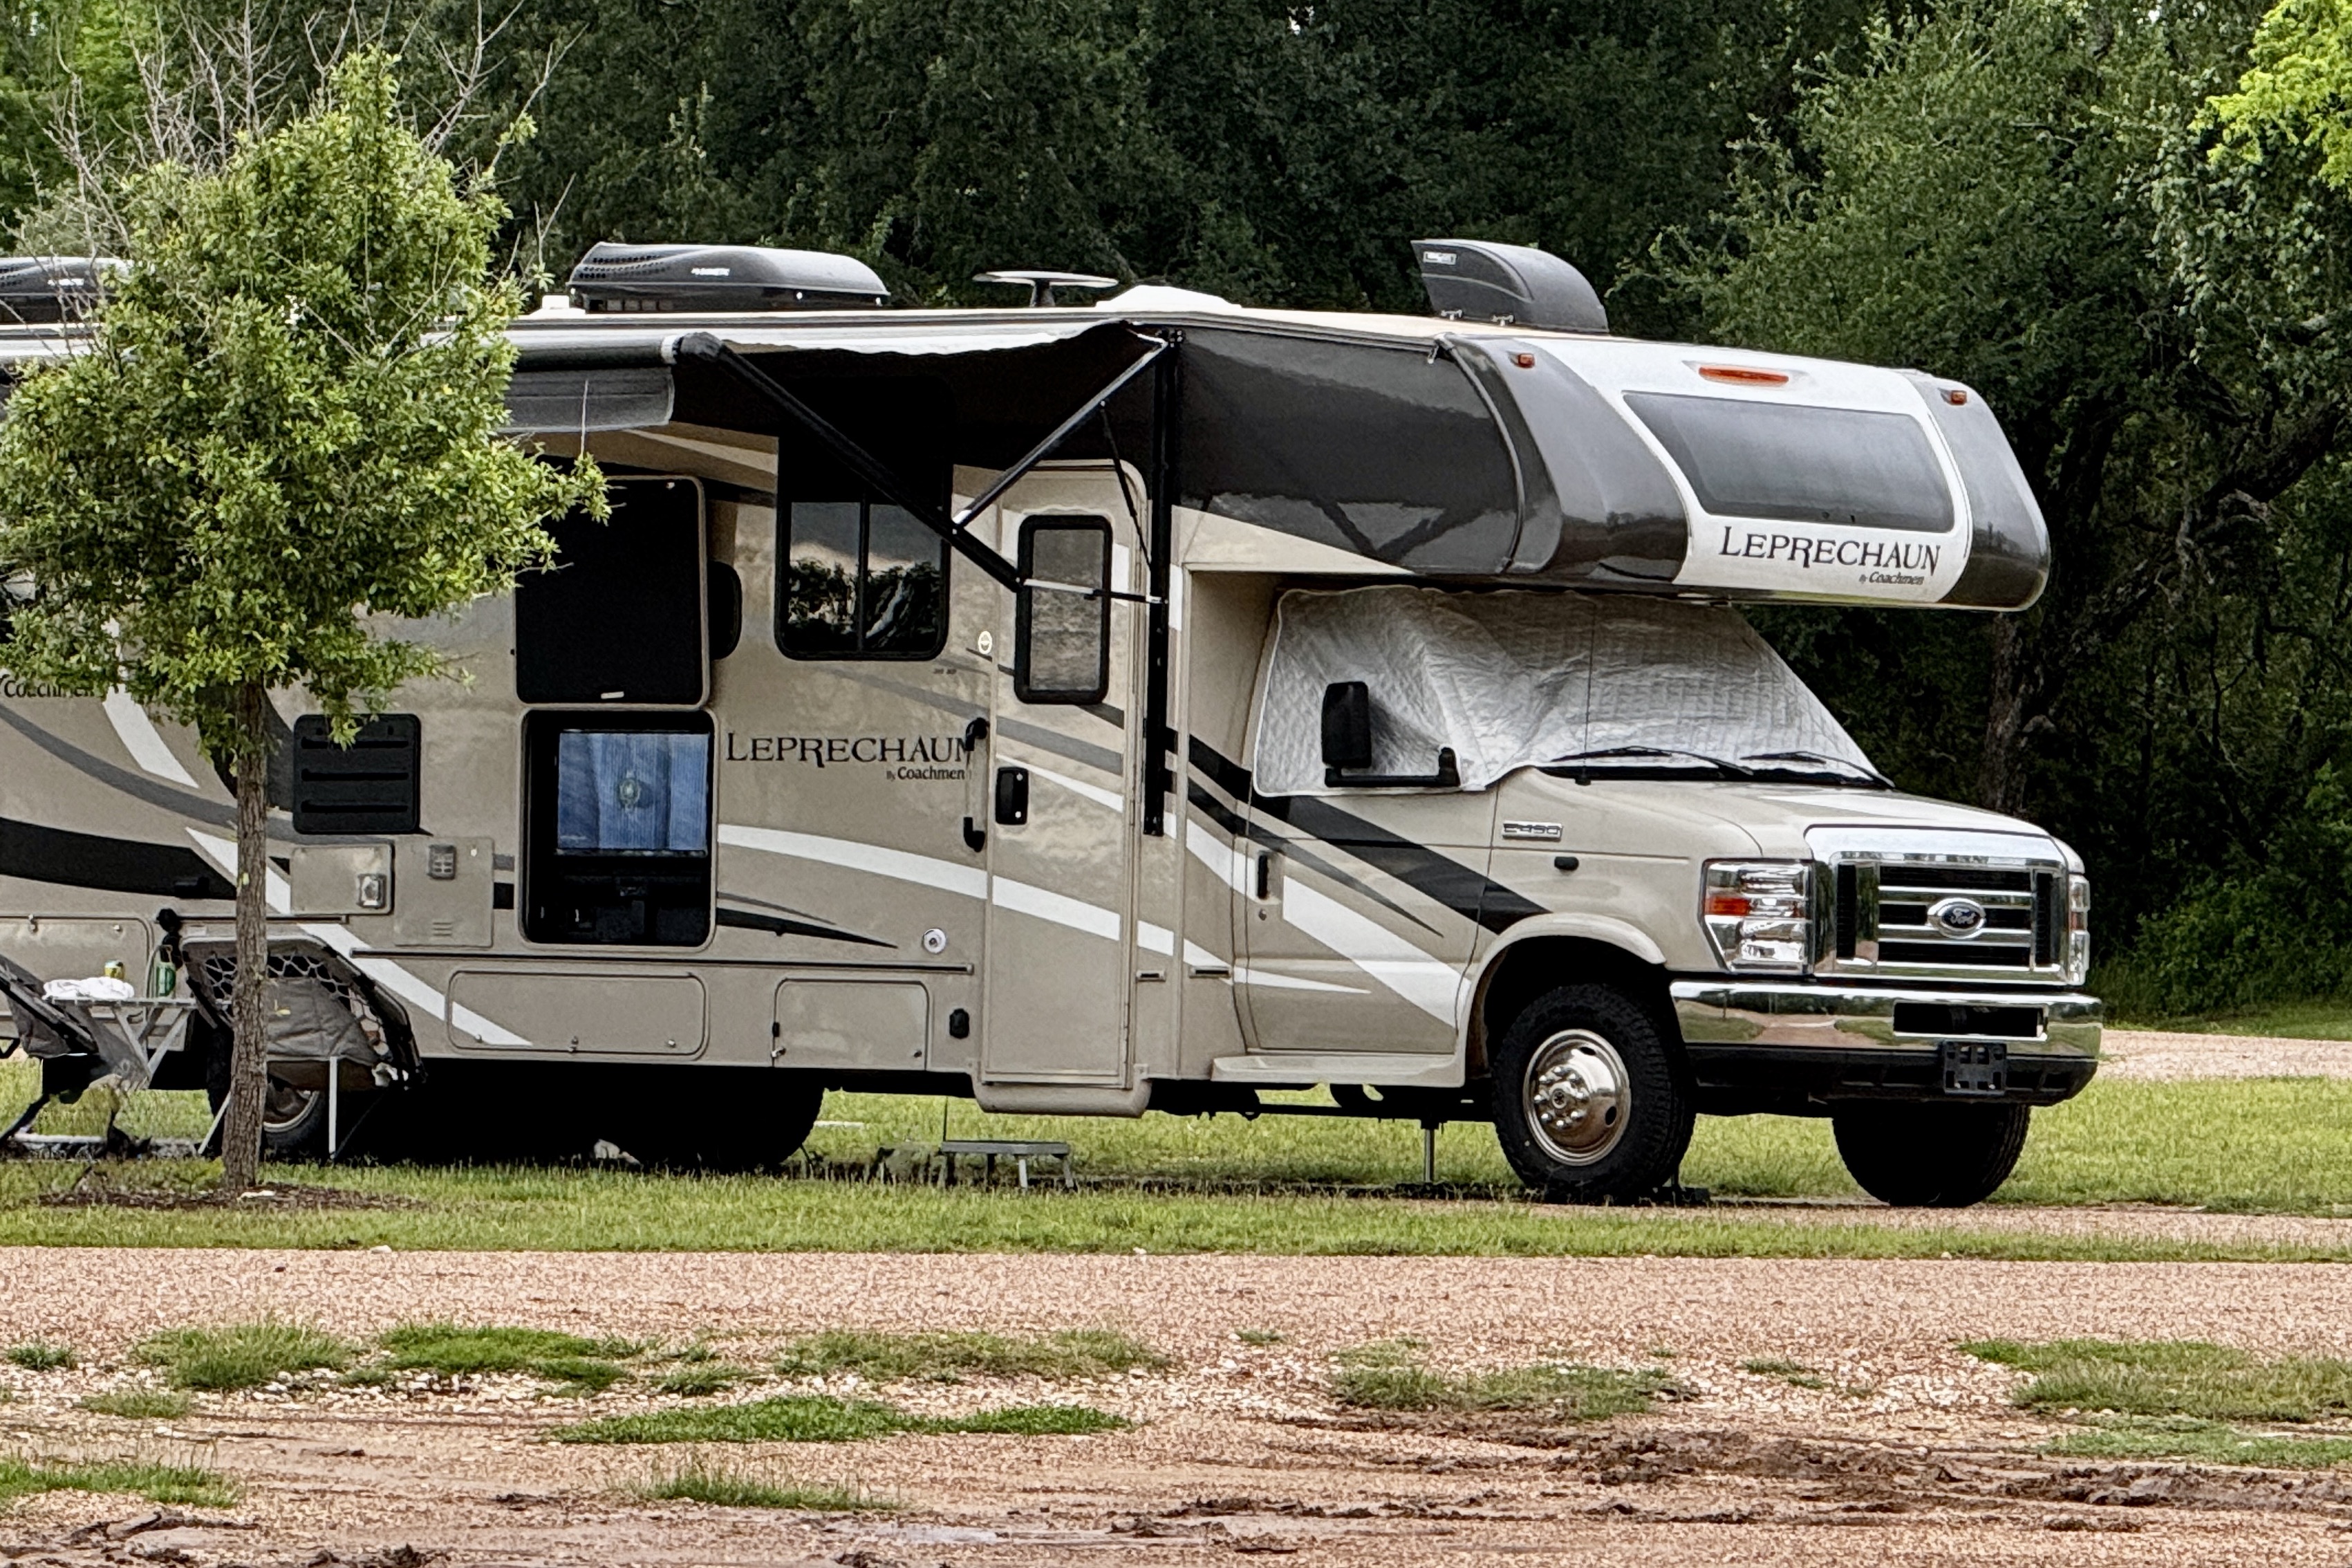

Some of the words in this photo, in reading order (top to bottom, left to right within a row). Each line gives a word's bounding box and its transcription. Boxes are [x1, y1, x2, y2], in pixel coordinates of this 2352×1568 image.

[1719, 525, 1941, 576] LEPRECHAUN
[4, 680, 95, 698] Coche
[727, 732, 971, 768] LEPRECHAUN
[897, 765, 965, 780] Coachmen
